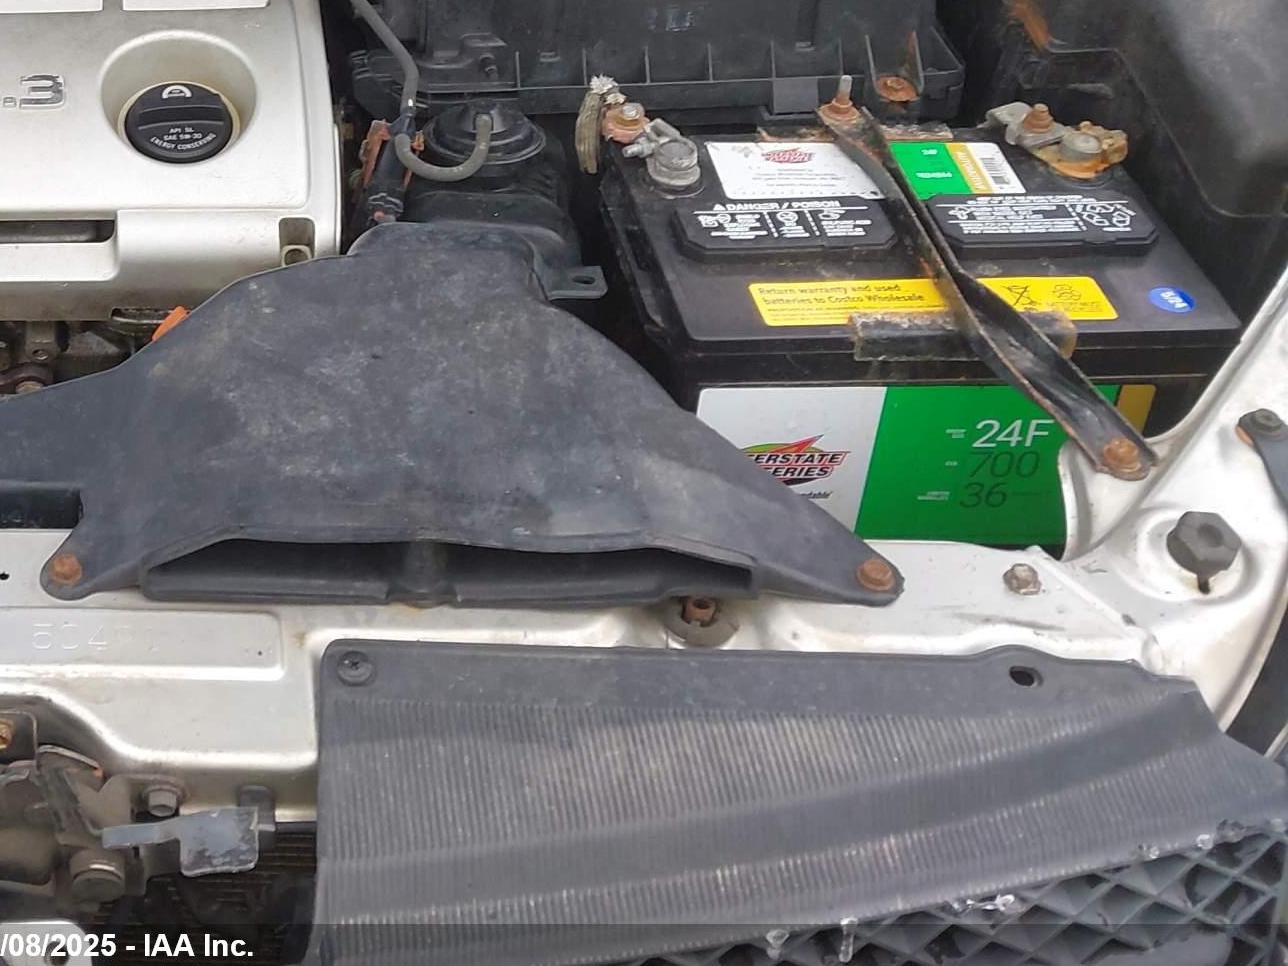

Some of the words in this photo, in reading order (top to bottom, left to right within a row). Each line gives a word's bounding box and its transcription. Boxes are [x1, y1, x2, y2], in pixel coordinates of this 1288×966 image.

[149, 136, 177, 149] ENERGY
[177, 133, 217, 150] CONSERVING
[725, 202, 780, 211] DANGER
[758, 287, 795, 295] Return
[799, 286, 848, 296] warranty
[851, 284, 872, 293] and
[876, 284, 900, 293] used
[763, 295, 812, 305] batteries
[813, 296, 826, 304] to
[828, 295, 864, 304] Costco
[866, 293, 924, 303] Wholesale
[972, 419, 1055, 448] 24F
[749, 453, 842, 464] ERSTATE
[969, 450, 1041, 478] 700
[768, 466, 831, 477] ERIES
[959, 482, 1007, 508] 36
